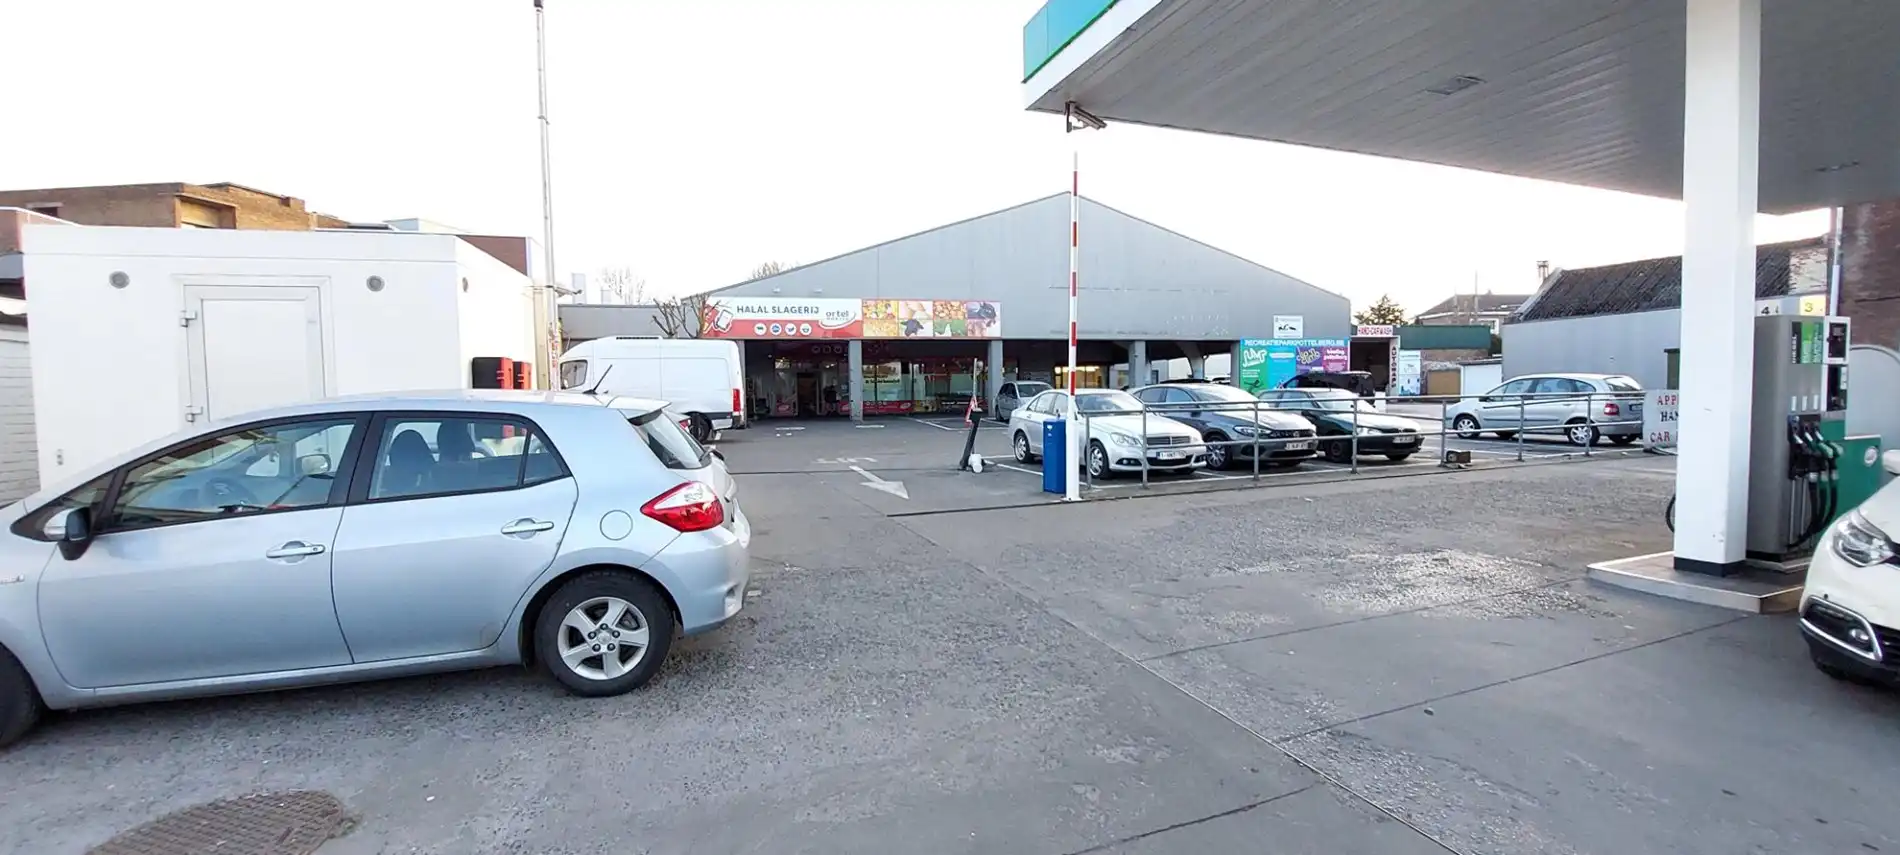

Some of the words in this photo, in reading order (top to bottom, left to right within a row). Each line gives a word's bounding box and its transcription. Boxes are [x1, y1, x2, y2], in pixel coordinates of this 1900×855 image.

[736, 305, 769, 314] HALAL
[771, 305, 820, 314] SLAGERIJ
[1761, 306, 1770, 314] 4
[1804, 302, 1814, 313] 3
[825, 309, 849, 318] ortel
[1657, 394, 1679, 406] APP
[1660, 410, 1679, 422] HAN
[1649, 431, 1671, 443] CAR
